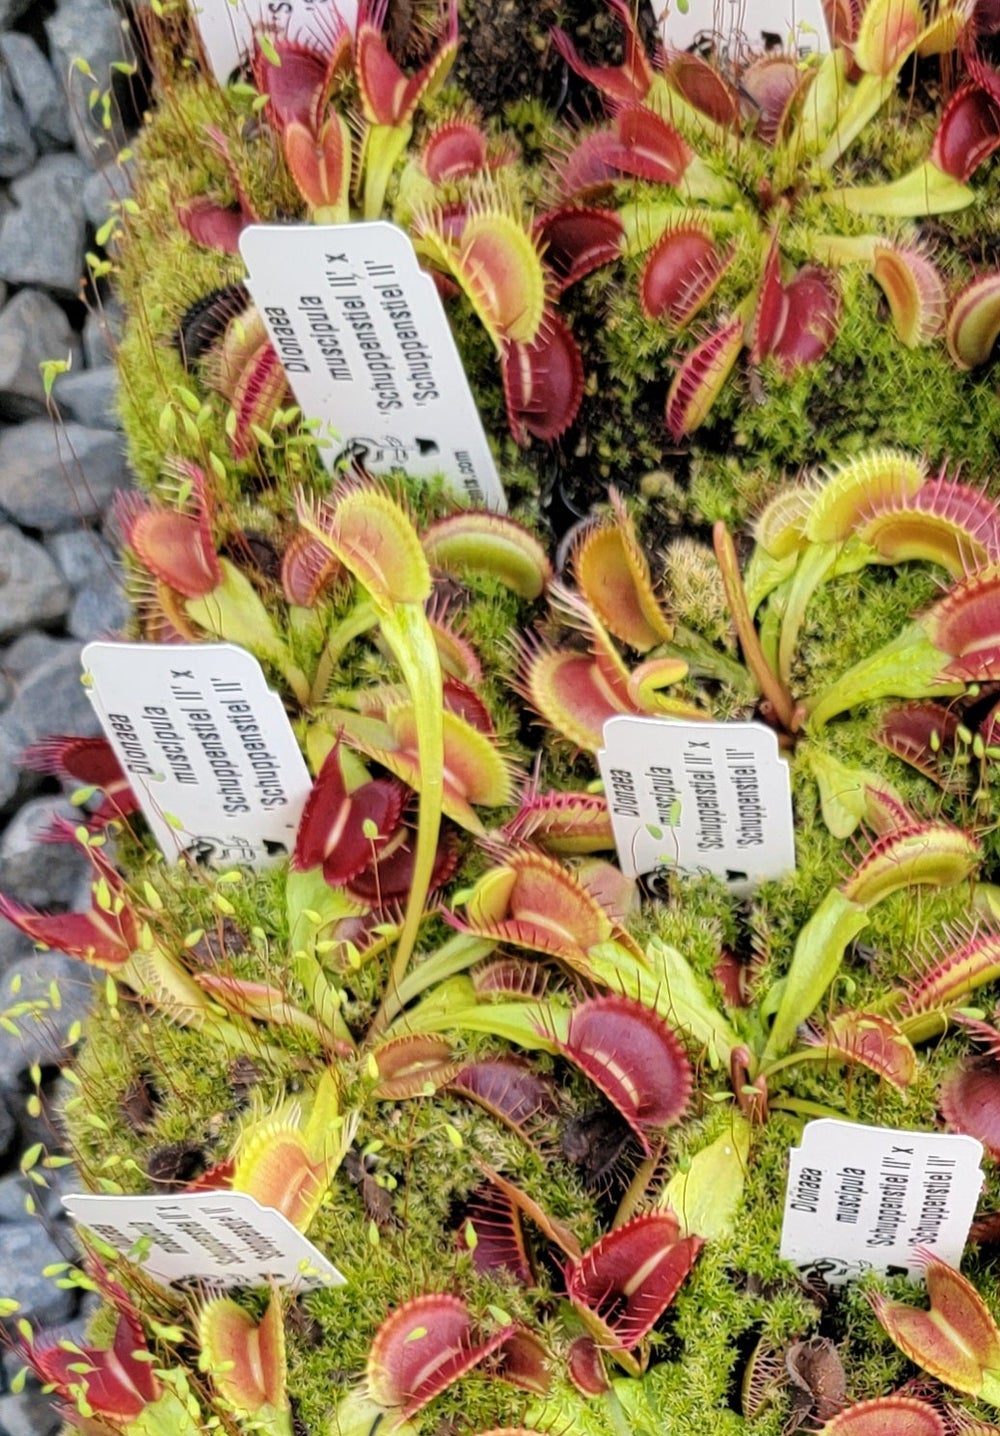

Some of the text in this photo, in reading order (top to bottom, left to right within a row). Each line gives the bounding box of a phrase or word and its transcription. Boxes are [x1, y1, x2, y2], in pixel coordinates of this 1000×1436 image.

[325, 253, 349, 263] x
[265, 307, 311, 372] Dionaea
[298, 295, 352, 381] muscipula
[336, 295, 404, 415] 'Schuppenstiel
[373, 284, 439, 406] 'Schuppenstiel
[171, 669, 194, 679] x
[108, 713, 154, 775] Dionaea
[142, 706, 198, 785] muscipula
[180, 708, 250, 817] 'Schuppenstiel
[220, 700, 288, 811] 'Schuppenstiel
[688, 741, 710, 749] x
[610, 769, 640, 818] Dionaea
[685, 770, 727, 852] 'Schuppenstiel
[728, 765, 767, 849] 'Schuppenstiel
[790, 1167, 823, 1214] Dionaea
[834, 1167, 869, 1224] muscipula
[866, 1172, 909, 1248] 'Schuppenstiel
[891, 1146, 915, 1155] x
